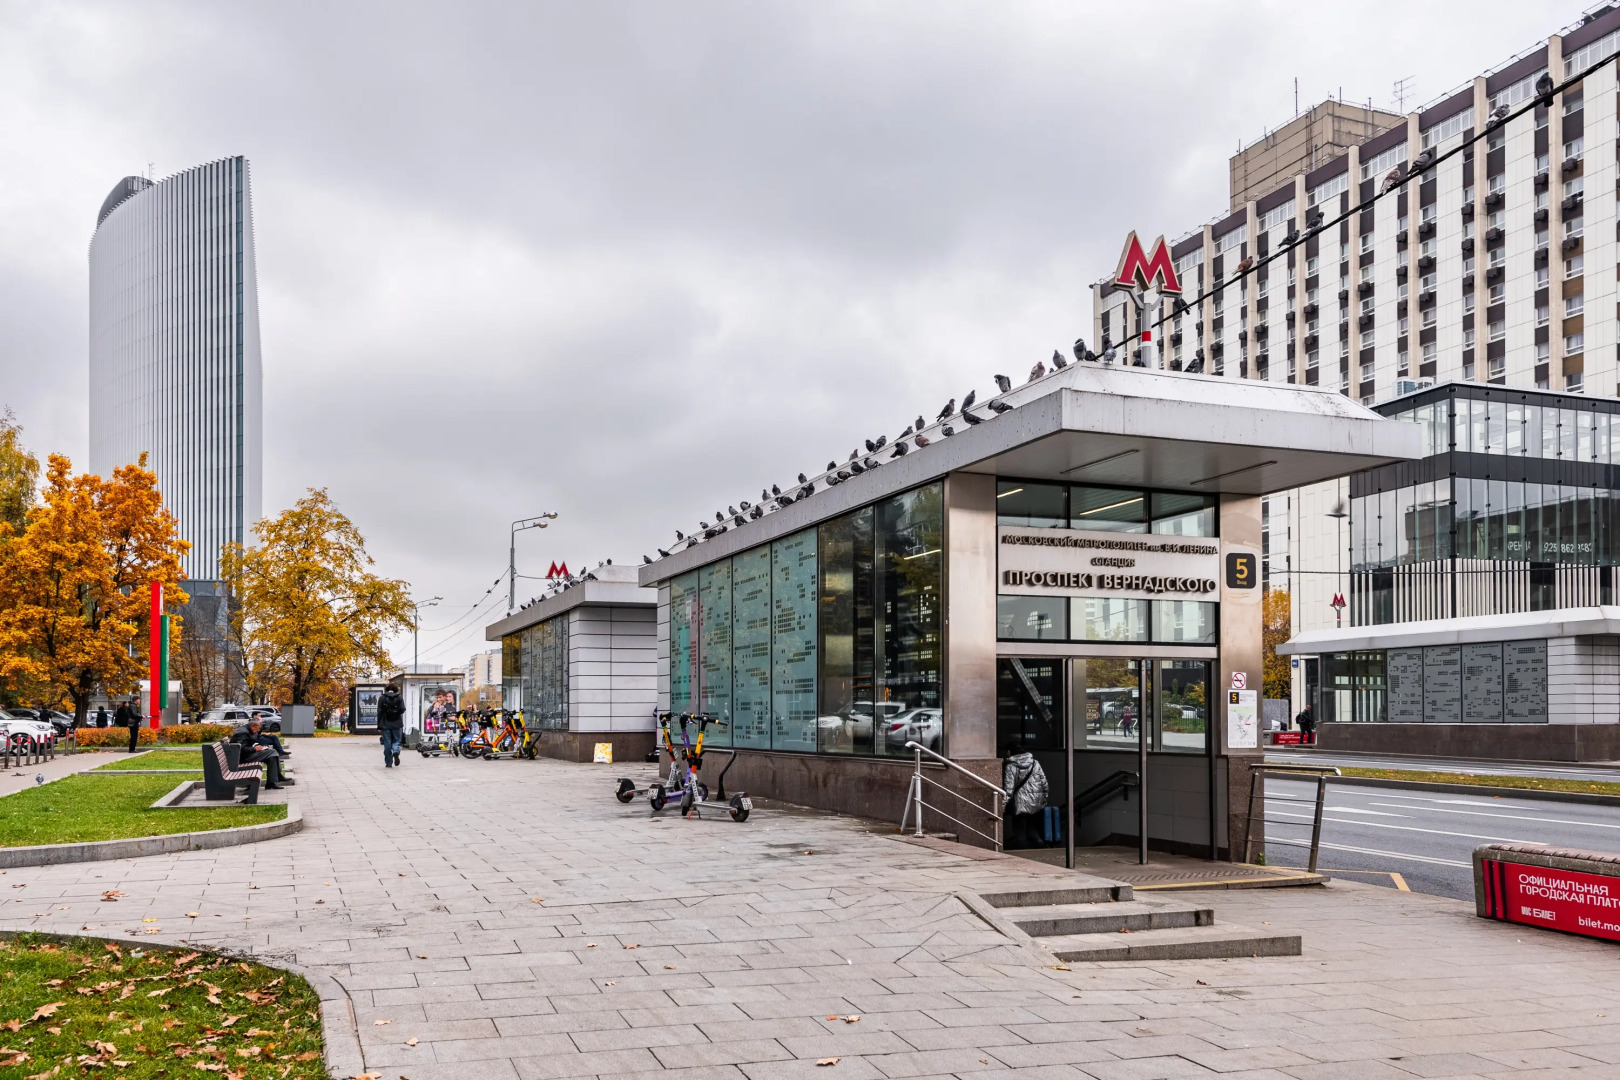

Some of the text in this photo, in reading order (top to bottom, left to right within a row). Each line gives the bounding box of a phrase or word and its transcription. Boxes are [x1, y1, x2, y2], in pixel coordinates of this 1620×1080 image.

[1112, 230, 1183, 296] М
[1002, 535, 1076, 548] МОСКОВСКИЙ
[1077, 539, 1148, 552] МЕТРОПОЛИТЕН
[1091, 557, 1135, 568] СТАНЦИЯ
[1236, 558, 1248, 579] 5
[1005, 570, 1217, 592] ПРОСПЕКТ ВЕРНАДСКОГО
[1518, 873, 1609, 896] ОФИЦИАЛЬНАЯ
[1519, 884, 1620, 909] ГОРОДСКАЯ ПЛАТ
